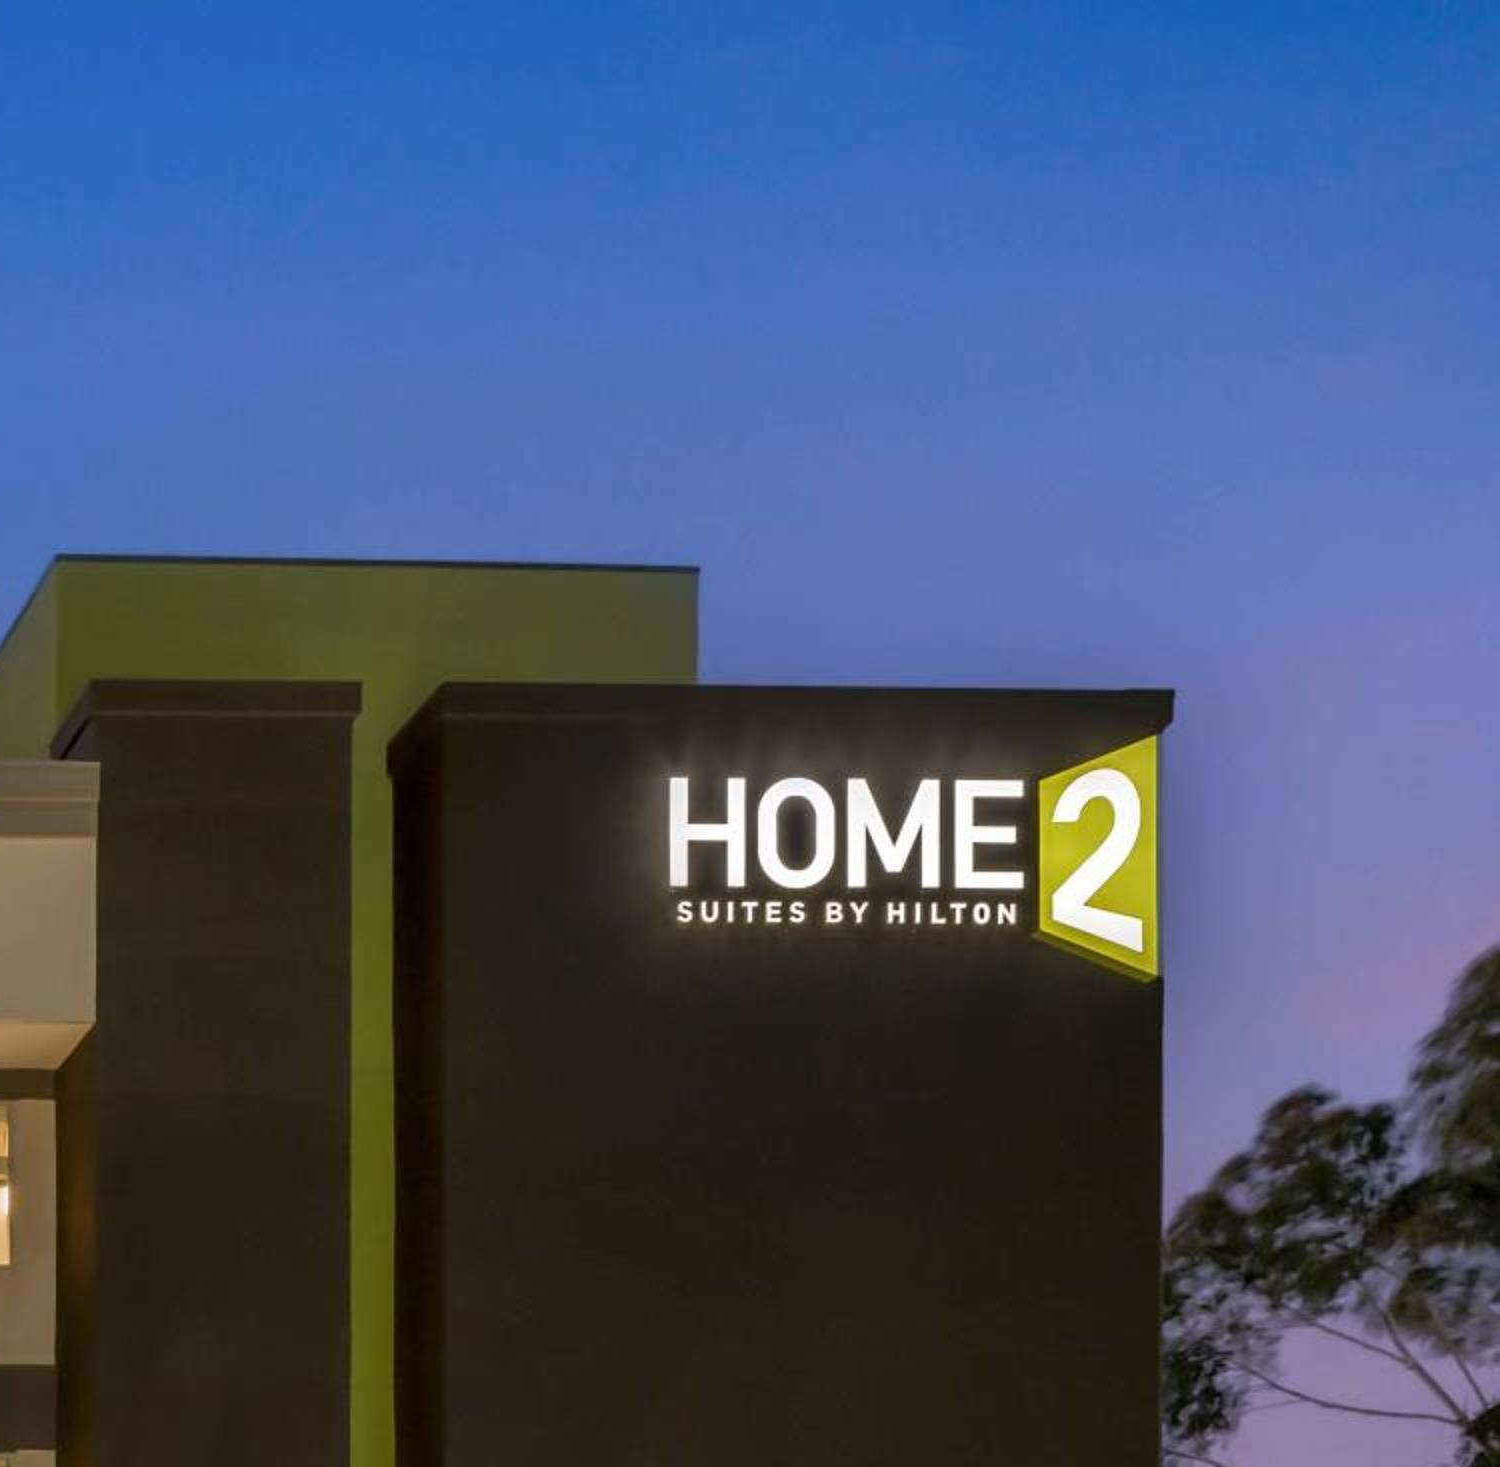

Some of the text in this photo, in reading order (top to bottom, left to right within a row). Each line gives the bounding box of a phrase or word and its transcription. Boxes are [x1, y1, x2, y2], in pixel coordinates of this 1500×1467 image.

[669, 768, 1143, 953] HOME 2
[677, 901, 1017, 924] SUITES BY HILTON
